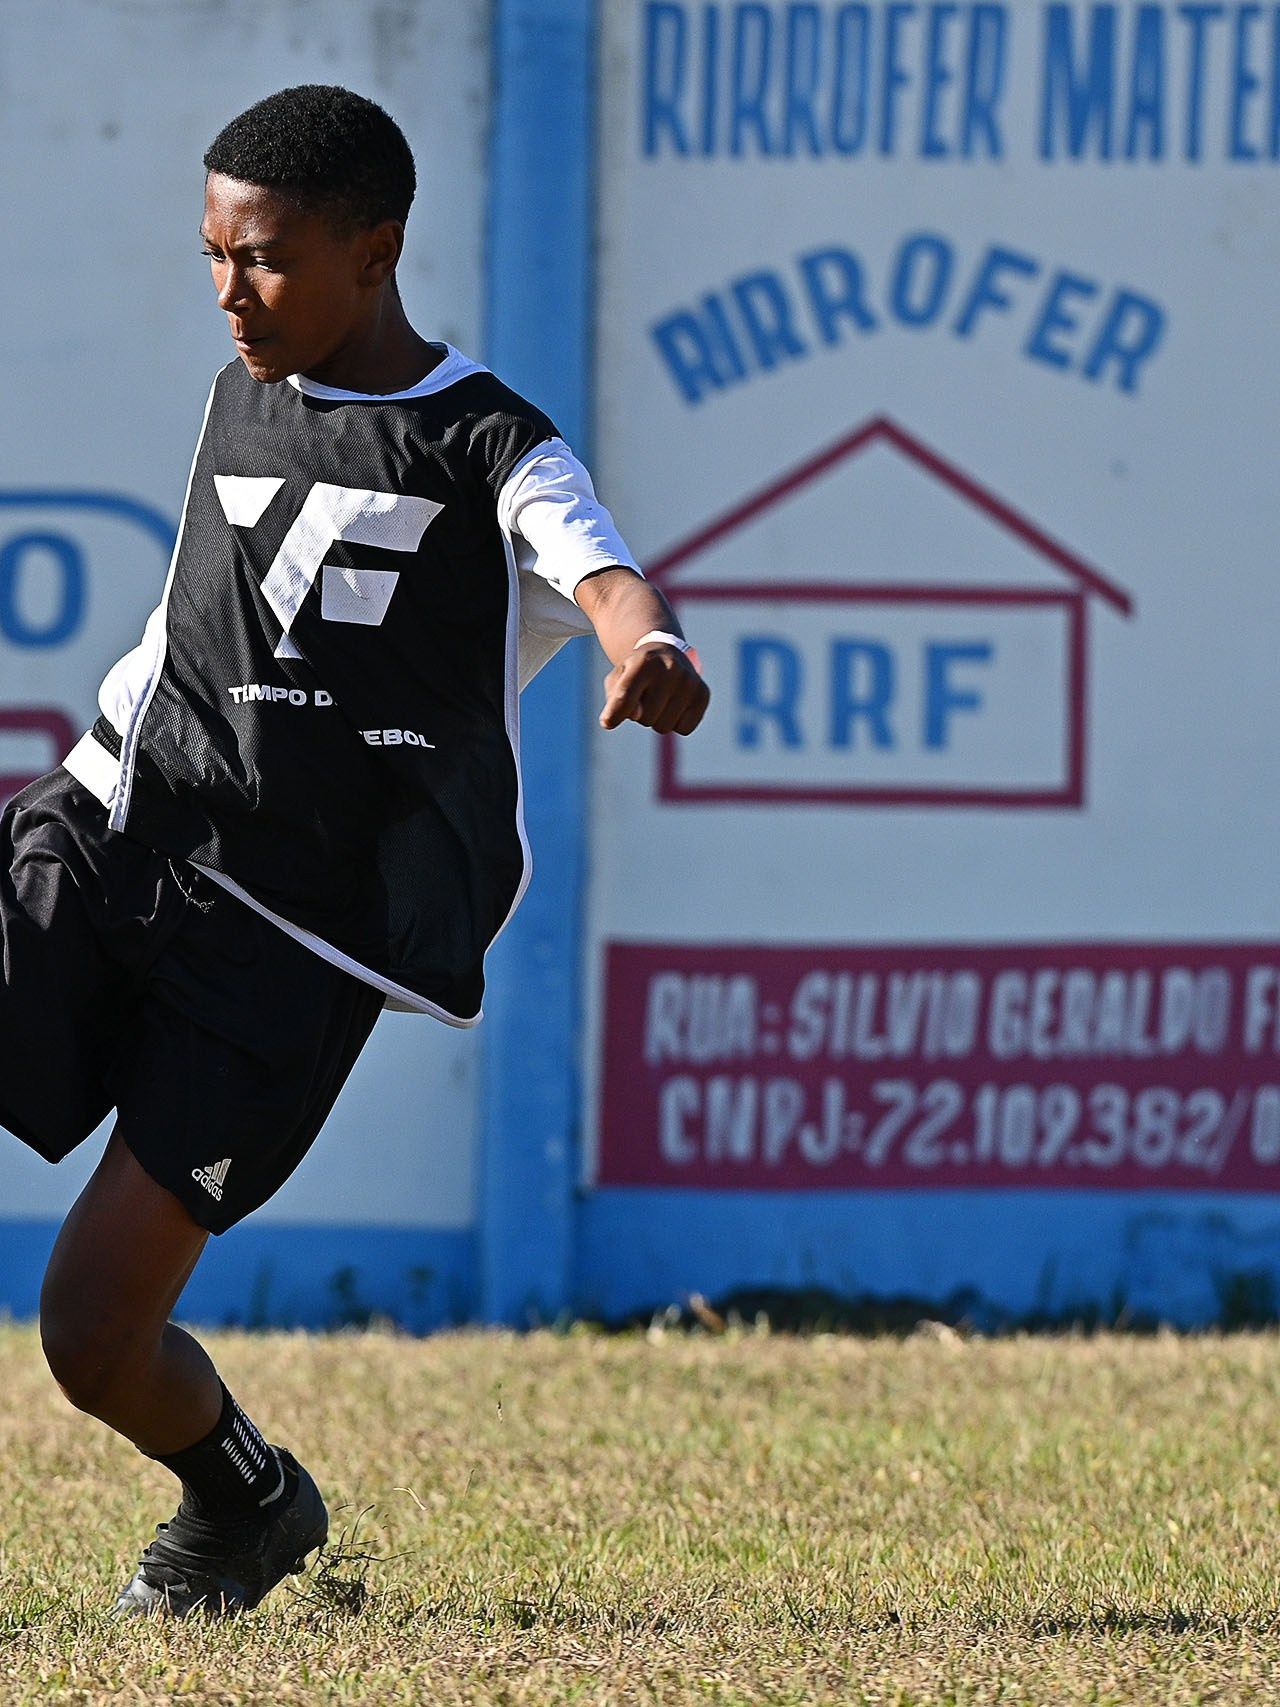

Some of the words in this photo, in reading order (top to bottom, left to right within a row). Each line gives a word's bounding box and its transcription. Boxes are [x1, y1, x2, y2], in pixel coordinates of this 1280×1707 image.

[640, 2, 1008, 161] RIRROFER
[1036, 3, 1280, 165] MATE
[650, 232, 1167, 406] RIRROFER
[314, 690, 338, 706] D
[358, 729, 436, 749] EBOL
[734, 632, 993, 753] RRF
